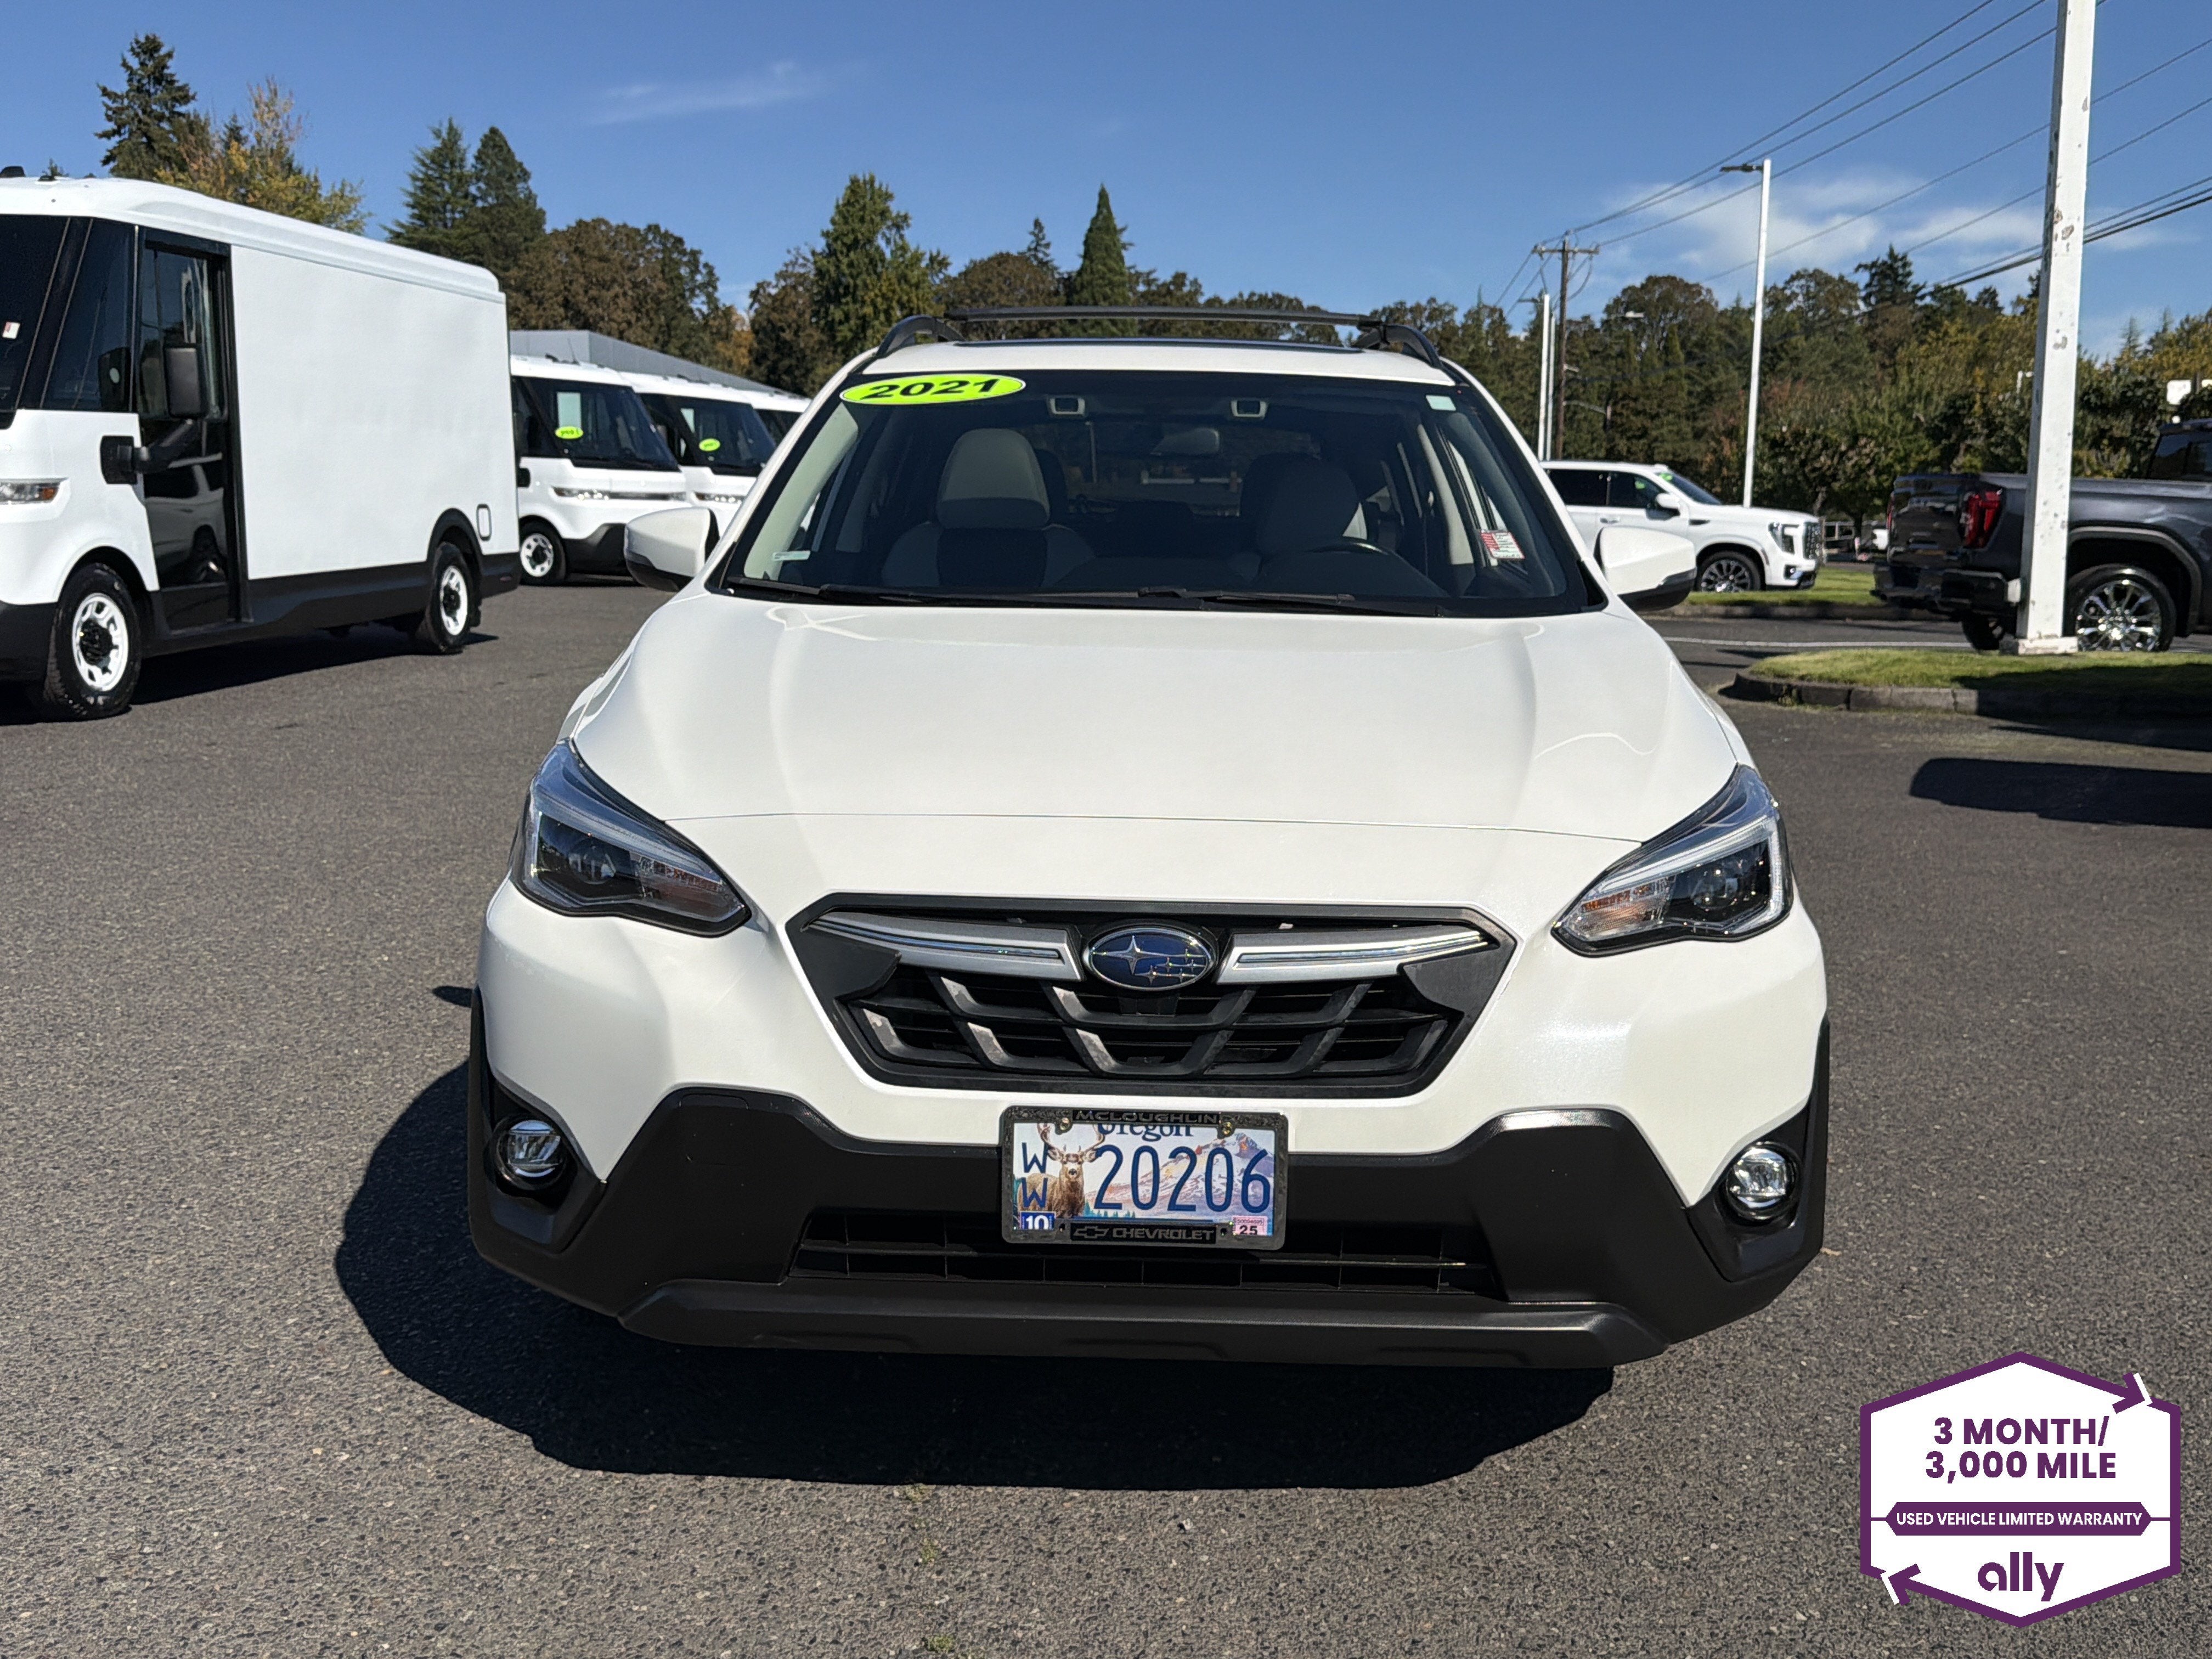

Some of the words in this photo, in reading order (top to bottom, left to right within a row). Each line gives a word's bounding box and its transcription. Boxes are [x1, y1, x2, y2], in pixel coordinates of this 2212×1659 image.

[860, 379, 1000, 400] 2021
[1075, 1110, 1217, 1124] MCLOUGHLIN
[1093, 1144, 1271, 1214] 20206
[1025, 1214, 1049, 1230] 10
[1239, 1224, 1258, 1235] 25
[1112, 1227, 1215, 1240] CHEVROLET
